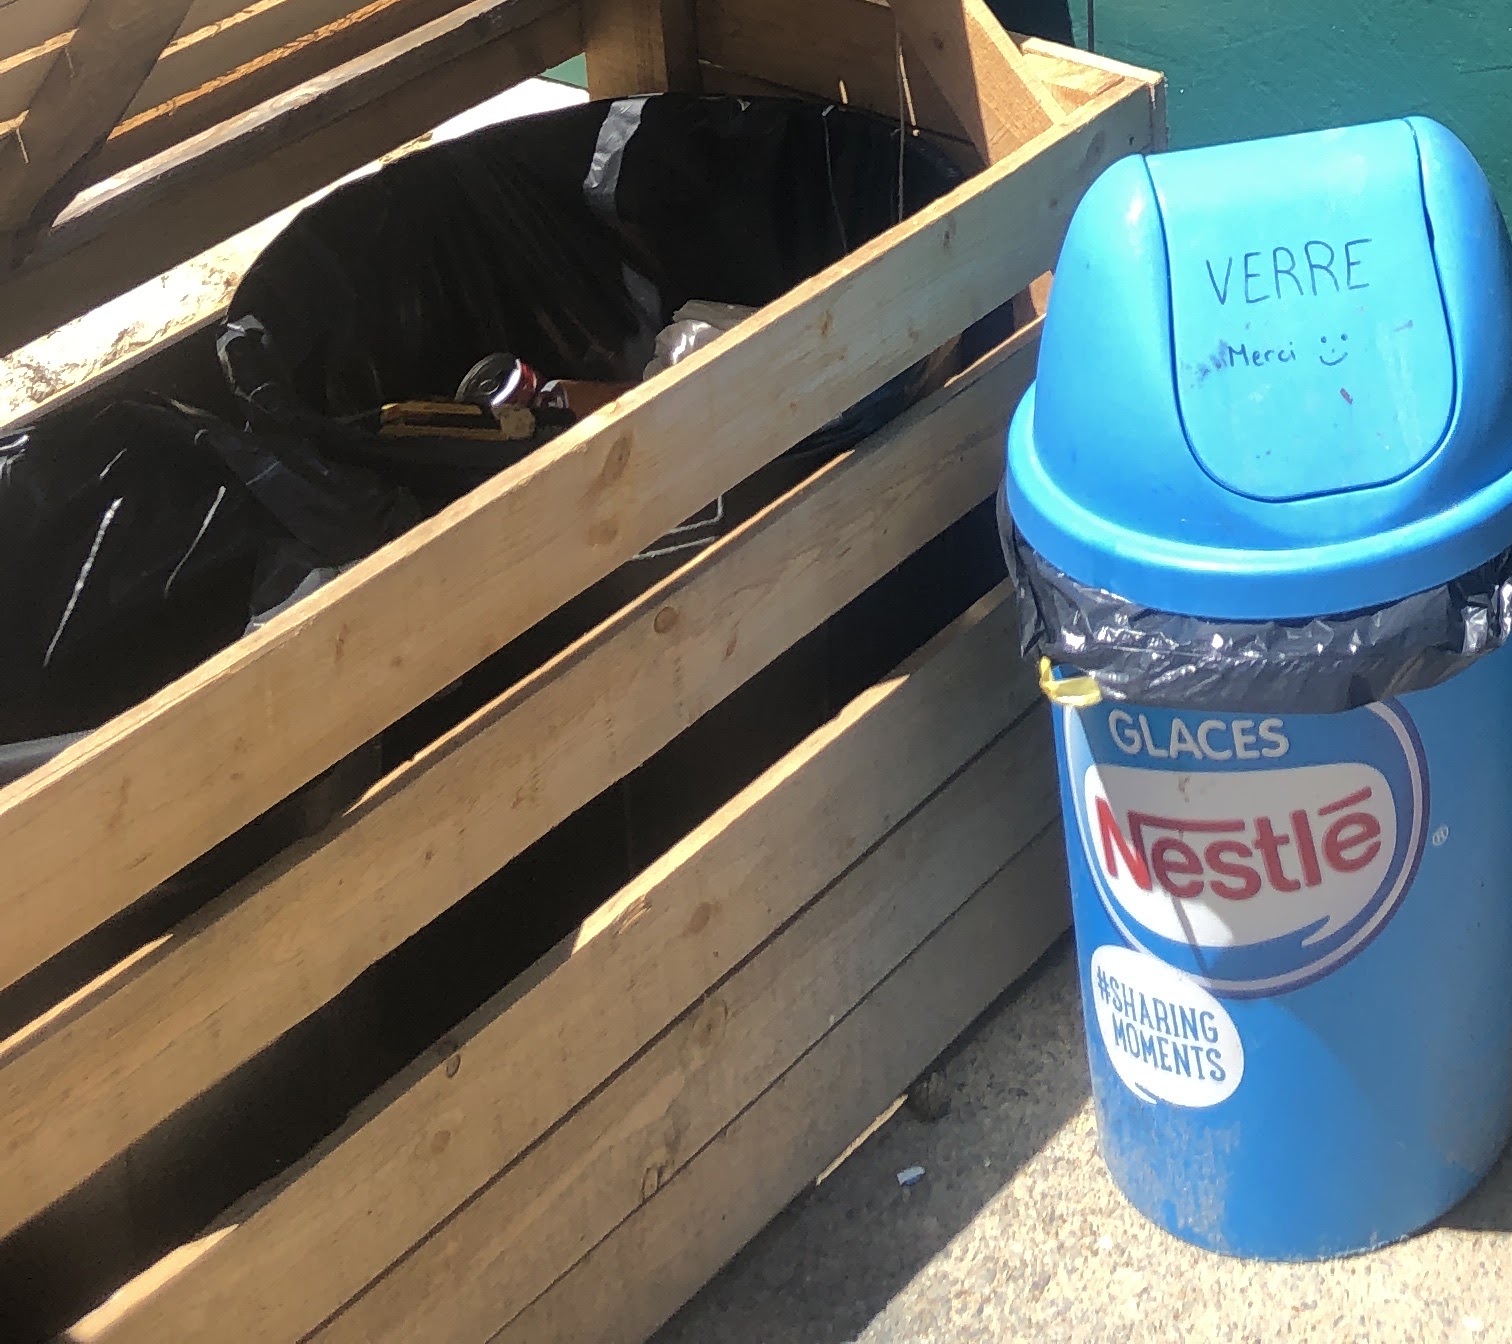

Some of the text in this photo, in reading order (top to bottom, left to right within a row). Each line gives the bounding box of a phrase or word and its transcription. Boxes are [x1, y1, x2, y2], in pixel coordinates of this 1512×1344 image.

[1206, 237, 1373, 306] VERRE
[1226, 340, 1297, 368] Merci
[1107, 709, 1289, 761] GLACES
[1094, 785, 1382, 900] Nestlé
[1096, 965, 1220, 1045] #SHARING
[1113, 1013, 1227, 1083] MOMENTS
